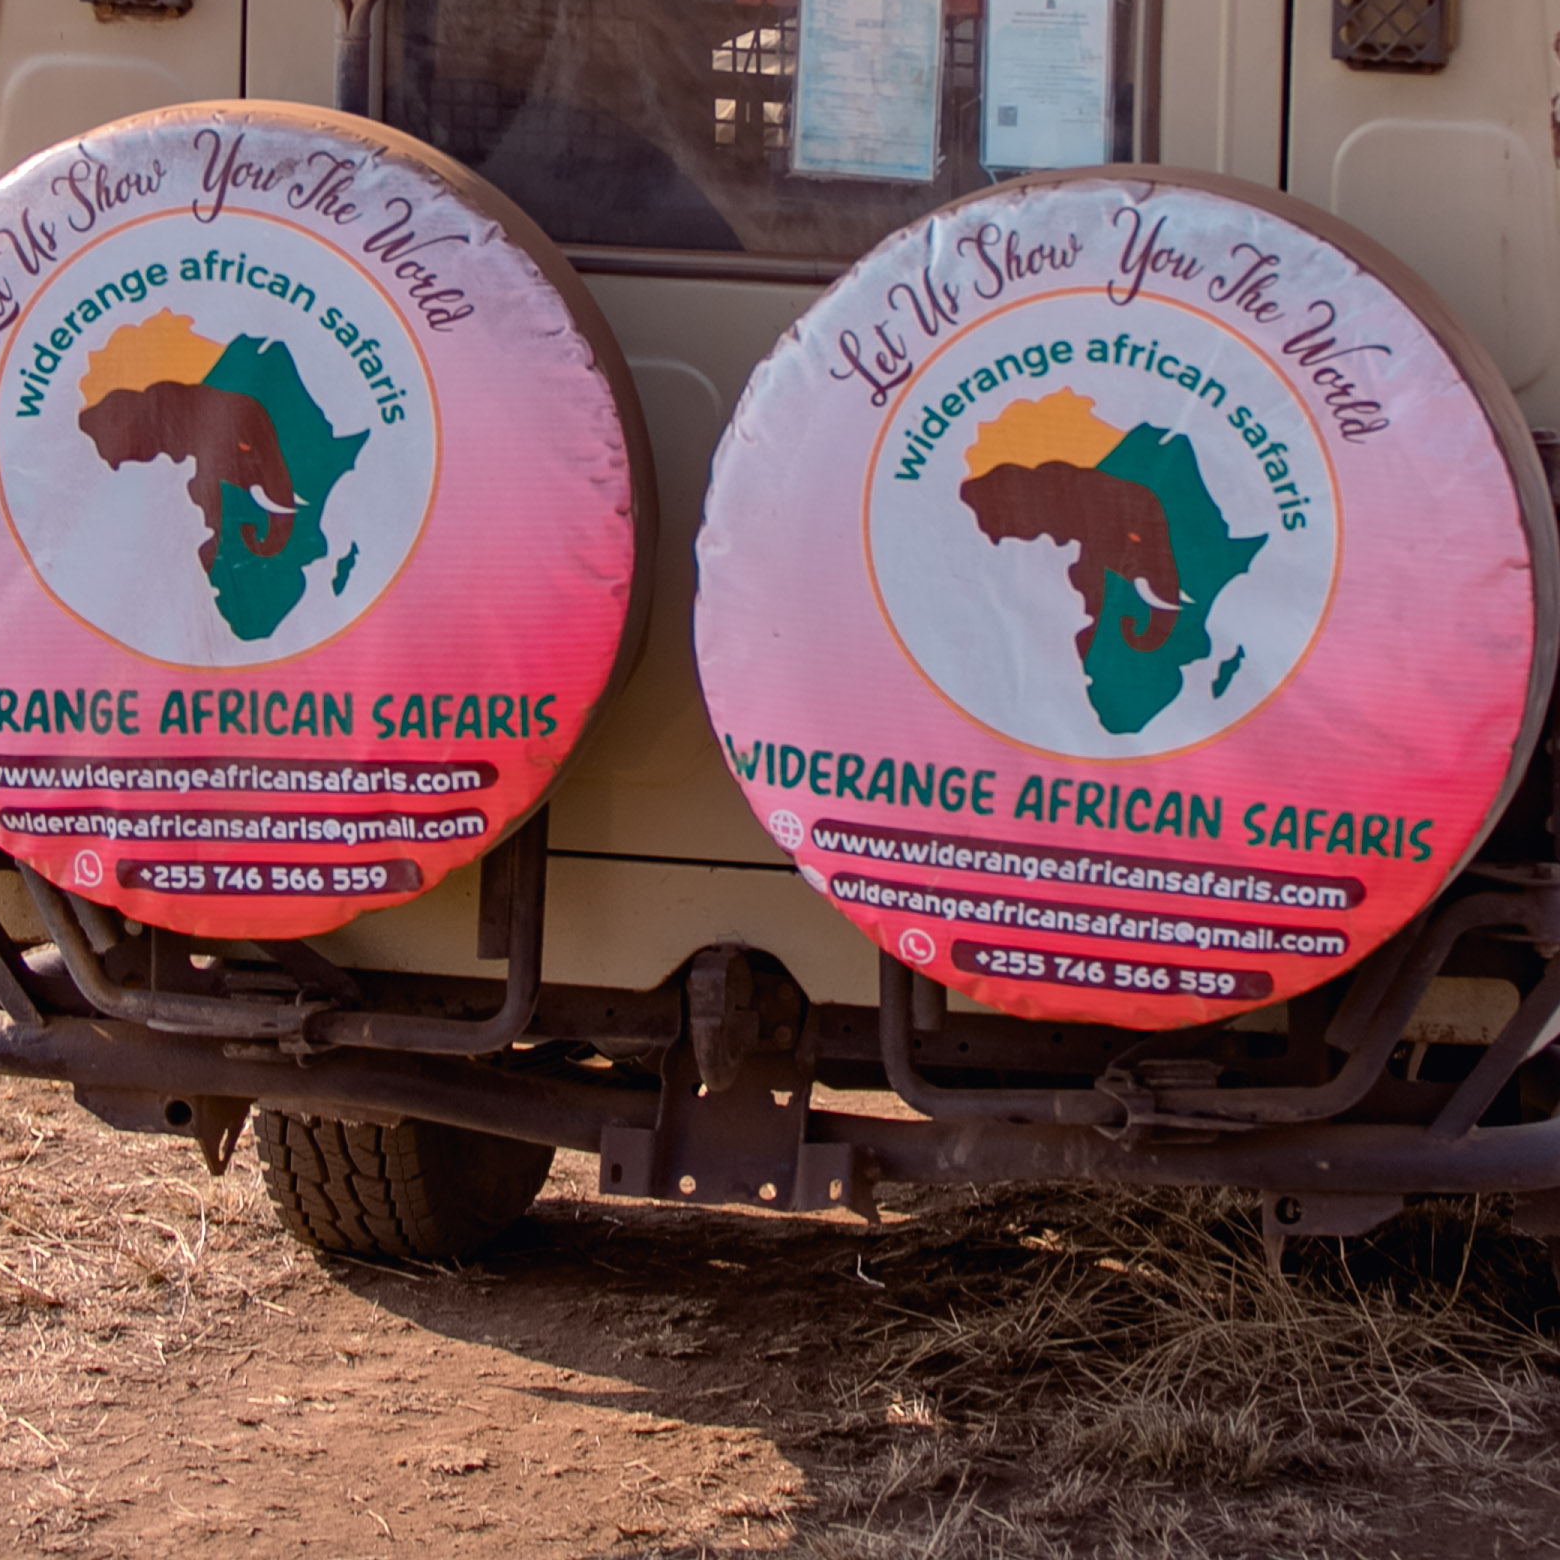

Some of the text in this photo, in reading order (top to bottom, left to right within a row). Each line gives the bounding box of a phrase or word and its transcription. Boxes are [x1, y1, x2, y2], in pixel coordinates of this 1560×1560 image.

[50, 158, 168, 233] Show
[191, 128, 284, 224] You
[287, 149, 364, 226] The
[361, 196, 476, 333] World
[15, 249, 408, 427] widerange african safaris
[829, 206, 1393, 446] Let Us Show You The World
[893, 332, 1312, 533] widerange african safaris
[158, 688, 354, 737] AFRICAN
[372, 693, 559, 740] SAFARIS
[1, 811, 486, 846] widerangeafricansafaris@gmail.com
[724, 732, 1434, 863] WIDERANGE AFRICAN SAFARIS
[139, 864, 388, 891] +255 746 566 559
[812, 826, 1348, 909] www.widerangeafricansafaris.com
[832, 878, 1346, 956] widerangeafricansafaris@gmail.com
[974, 950, 1237, 997] +255 746 566 559
